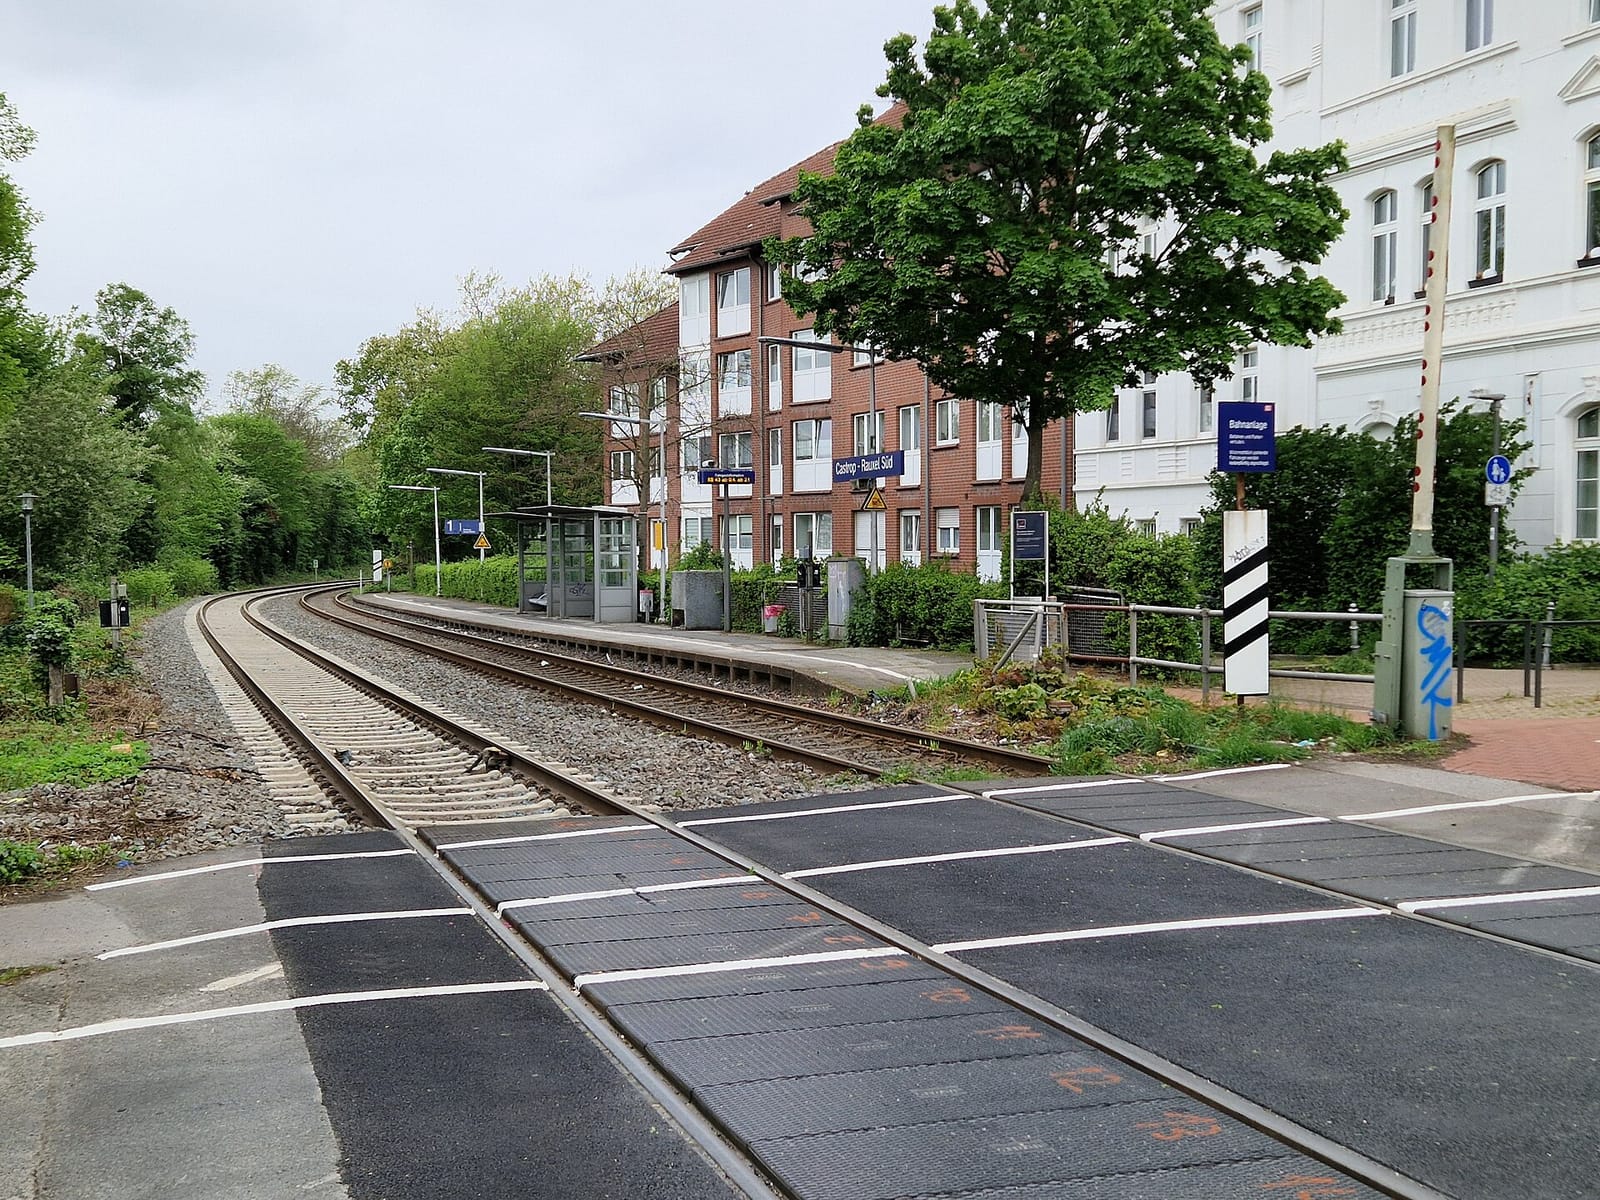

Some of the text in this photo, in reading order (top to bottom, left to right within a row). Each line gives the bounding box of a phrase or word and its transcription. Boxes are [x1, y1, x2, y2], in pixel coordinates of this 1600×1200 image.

[1229, 419, 1268, 431] Bahnanlage
[835, 461, 857, 476] Castrop
[861, 457, 880, 472] Rauxel
[881, 455, 893, 470] Süd
[446, 520, 452, 531] 1
